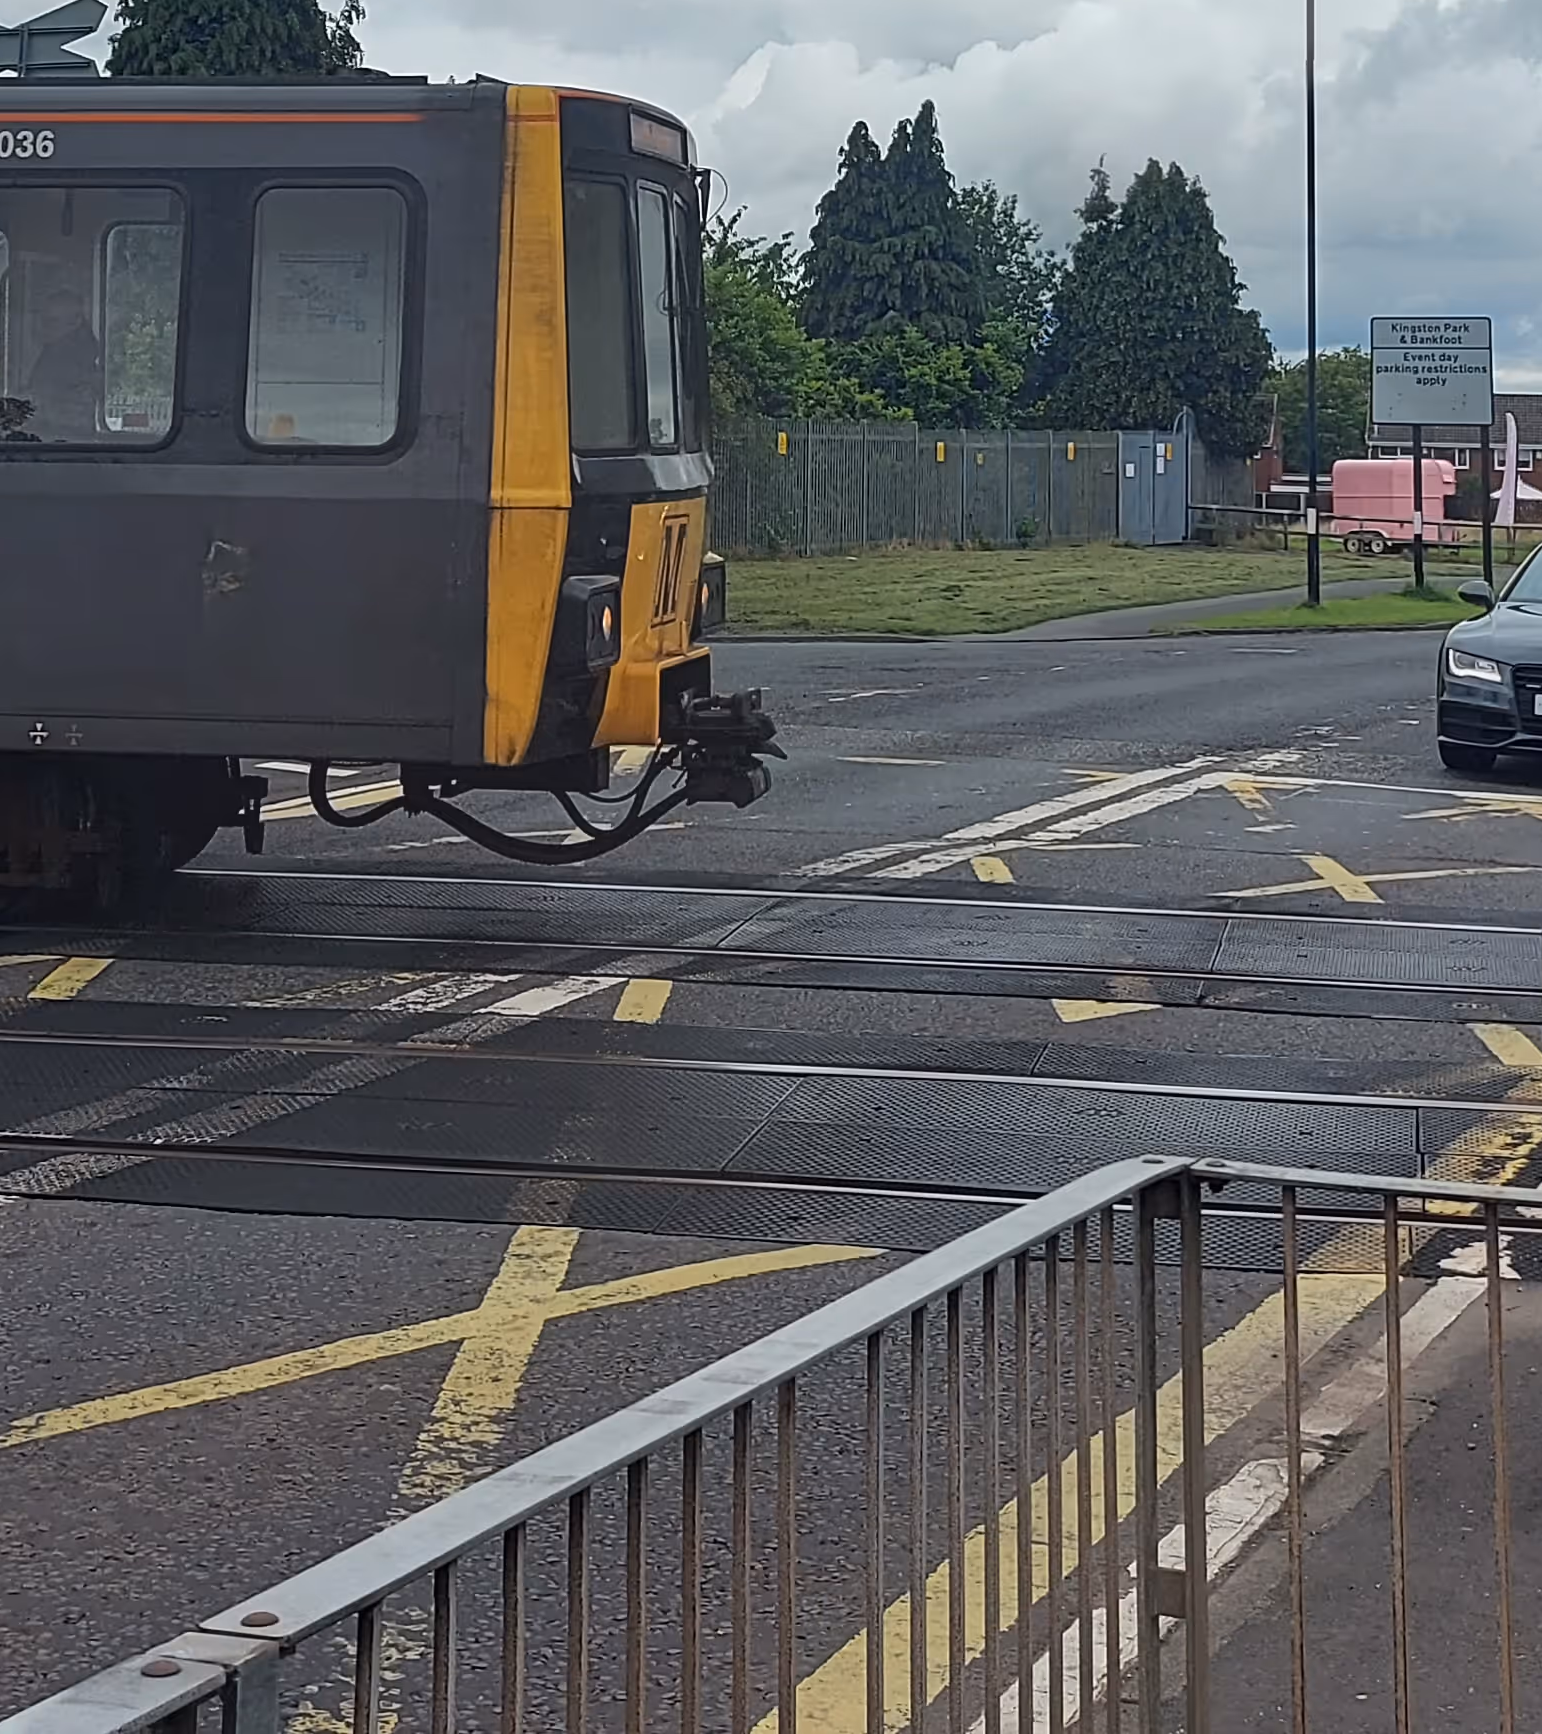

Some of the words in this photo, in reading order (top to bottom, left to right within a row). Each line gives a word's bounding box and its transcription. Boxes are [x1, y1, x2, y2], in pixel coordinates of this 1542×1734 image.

[1391, 323, 1441, 334] Kingston
[1443, 323, 1470, 333] Park
[1399, 335, 1407, 344] &
[1410, 335, 1462, 345] Bankfoot
[1403, 352, 1436, 362] Event
[1438, 352, 1459, 363] day
[1376, 364, 1419, 374] parking
[1421, 364, 1487, 374] restrictions
[1416, 376, 1447, 386] apply
